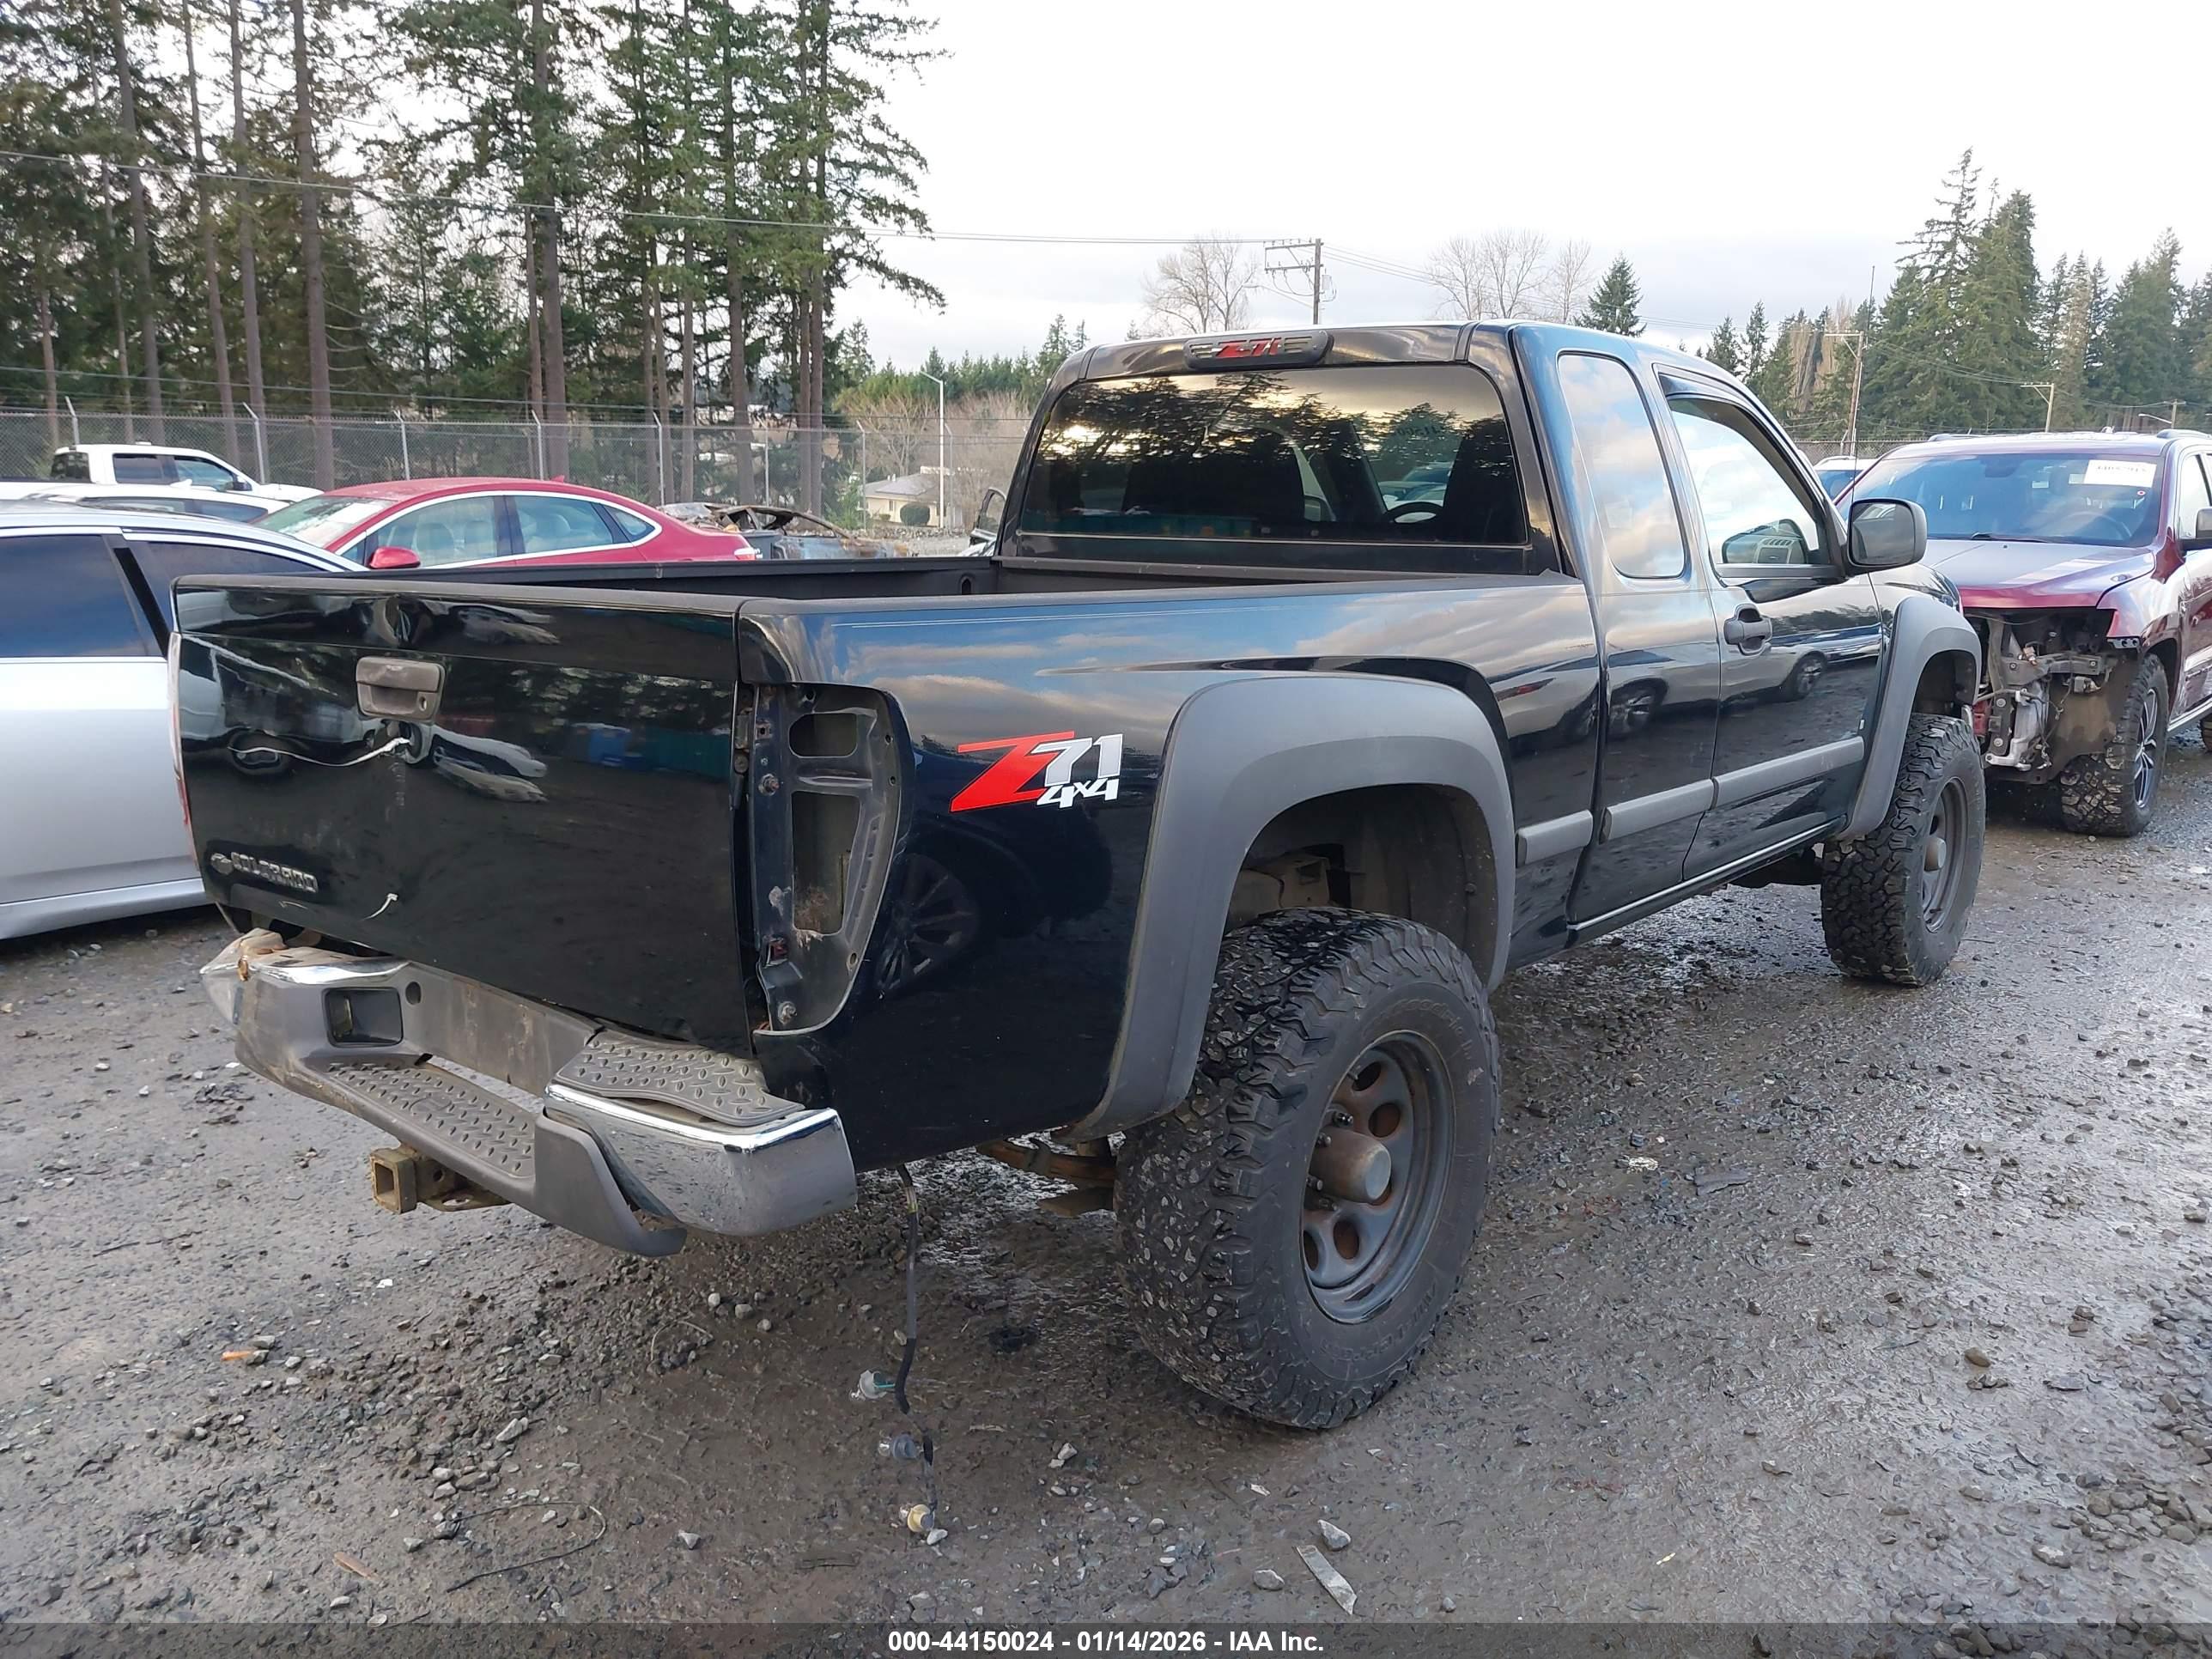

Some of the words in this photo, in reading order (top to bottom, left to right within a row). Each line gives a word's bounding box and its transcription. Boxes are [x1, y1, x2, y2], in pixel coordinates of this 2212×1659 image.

[1215, 337, 1282, 358] Z71
[949, 730, 1123, 812] Z71
[1036, 777, 1120, 809] 4x4
[230, 851, 319, 893] COLORADO
